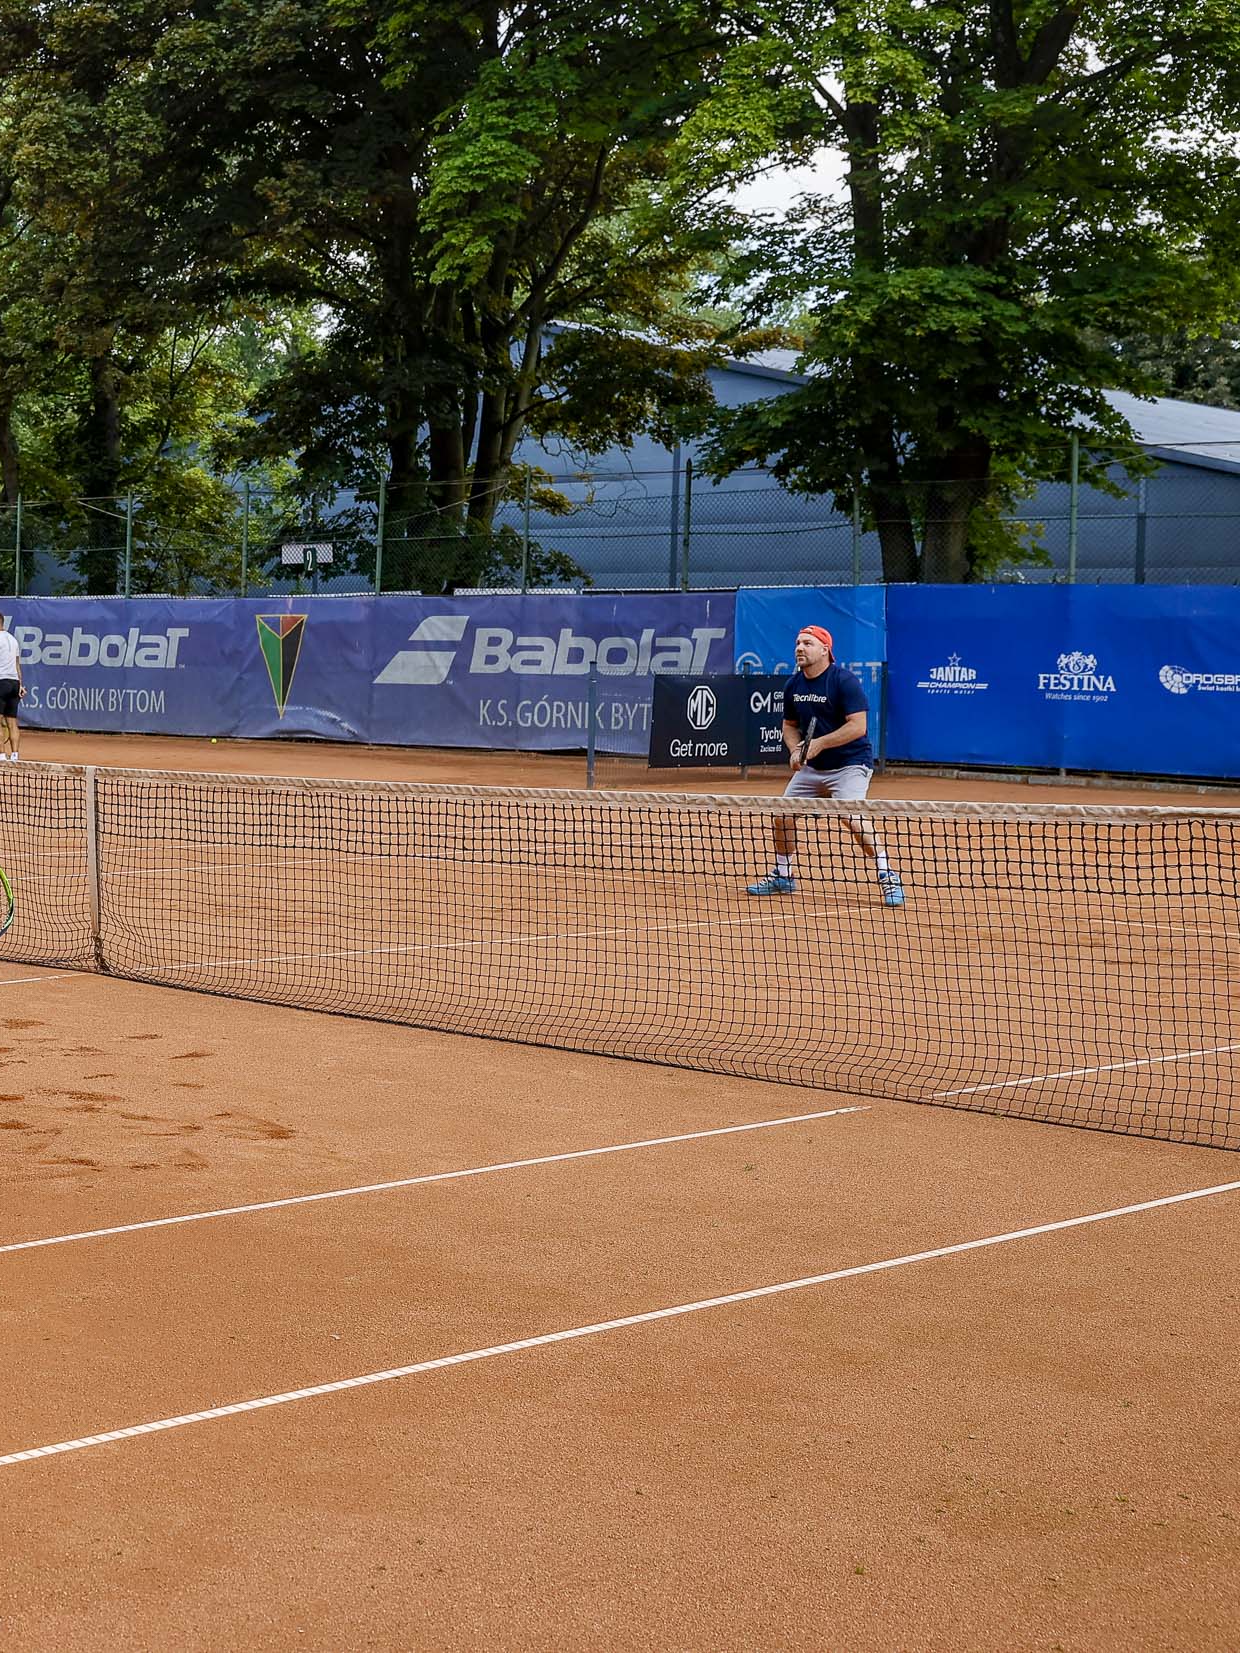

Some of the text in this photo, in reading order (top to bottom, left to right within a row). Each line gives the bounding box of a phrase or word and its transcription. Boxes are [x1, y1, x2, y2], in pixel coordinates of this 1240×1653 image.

[306, 550, 313, 571] 2
[929, 666, 977, 682] JANTAR
[1038, 674, 1116, 692] FESTINA
[929, 681, 976, 689] CHAMPION
[46, 682, 104, 711] GÓRNIK
[109, 688, 165, 713] BYTOM
[479, 695, 652, 731] K.S. GÓRNIK BYT
[688, 687, 715, 728] MG
[760, 726, 783, 743] Tychy
[670, 739, 728, 757] Get more
